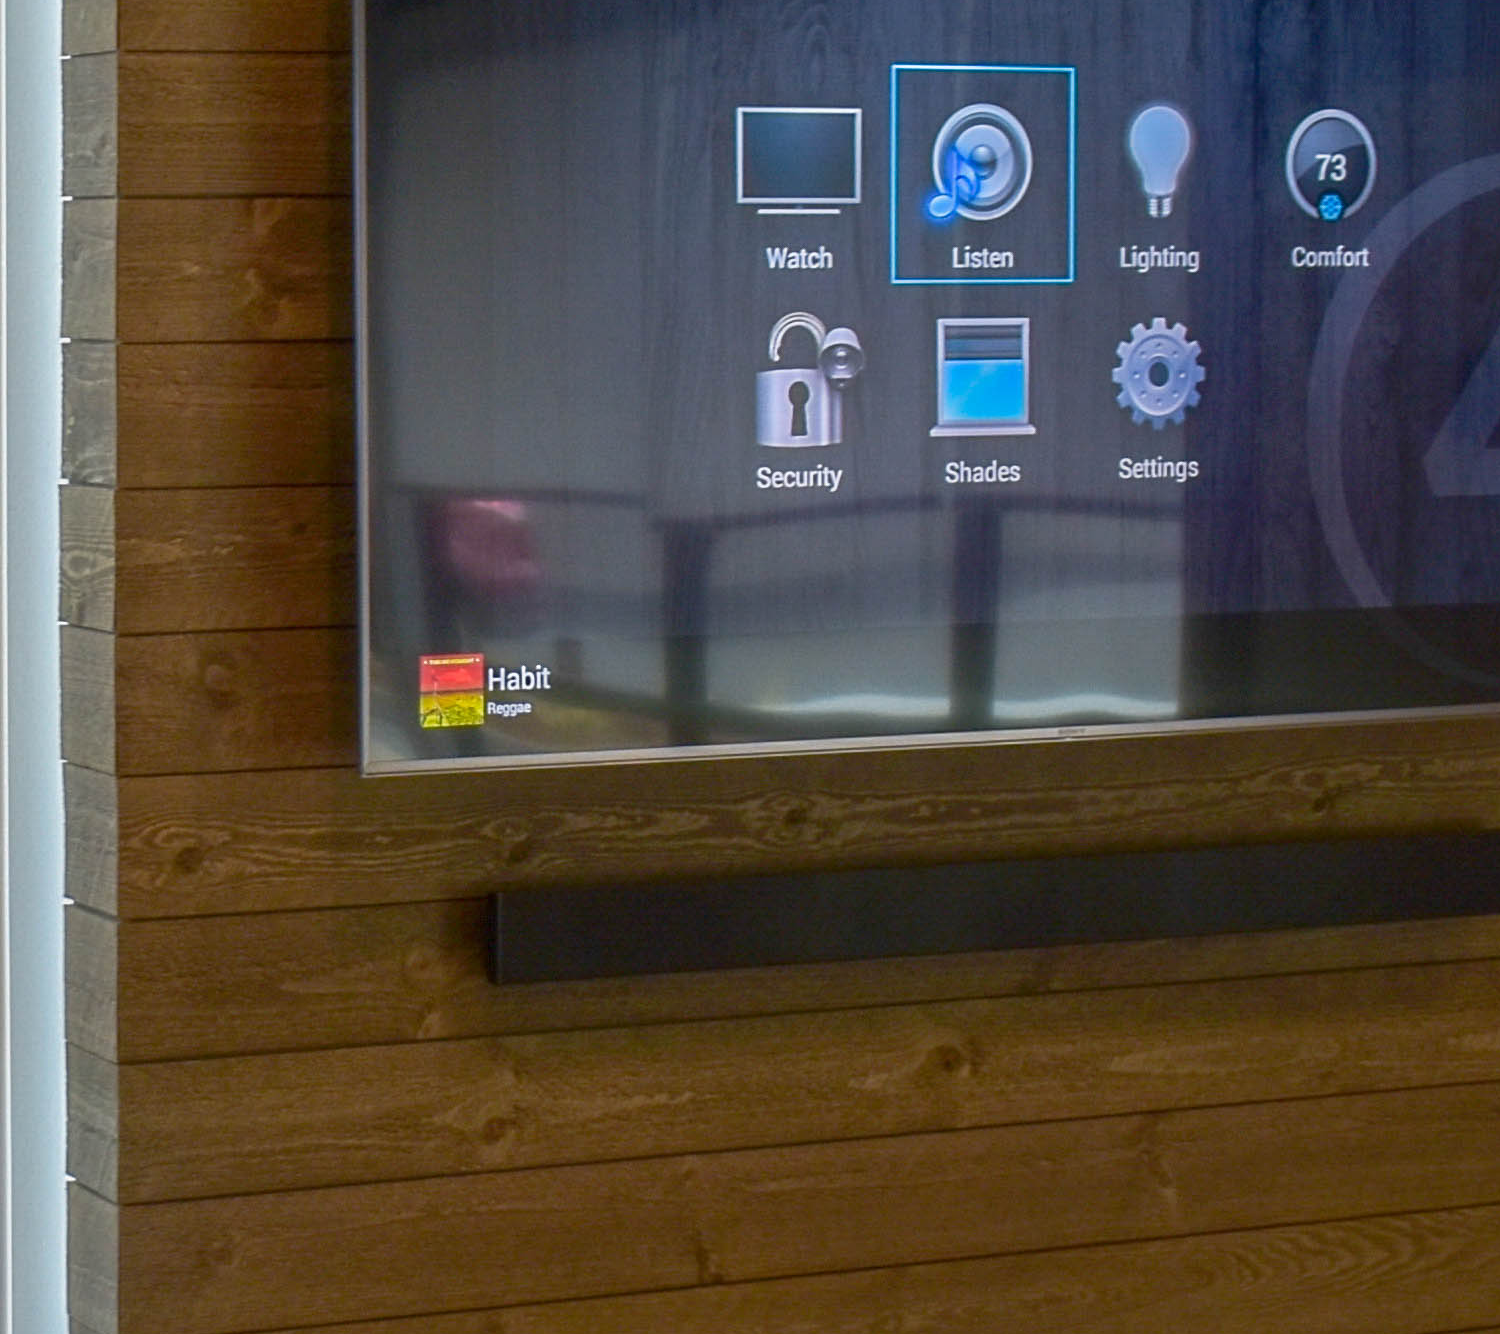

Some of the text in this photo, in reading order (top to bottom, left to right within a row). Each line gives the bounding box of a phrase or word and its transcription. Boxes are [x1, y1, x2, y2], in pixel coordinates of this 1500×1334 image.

[1314, 153, 1347, 182] 73
[765, 246, 834, 271] Watch
[951, 246, 1014, 271] Listen
[1119, 245, 1200, 276] Lighting
[1291, 245, 1370, 270] Comfort
[755, 464, 843, 494] Security
[944, 460, 1022, 485] Shades
[1118, 456, 1200, 483] Settings
[487, 664, 552, 692] Habit
[487, 701, 532, 717] Reggae
